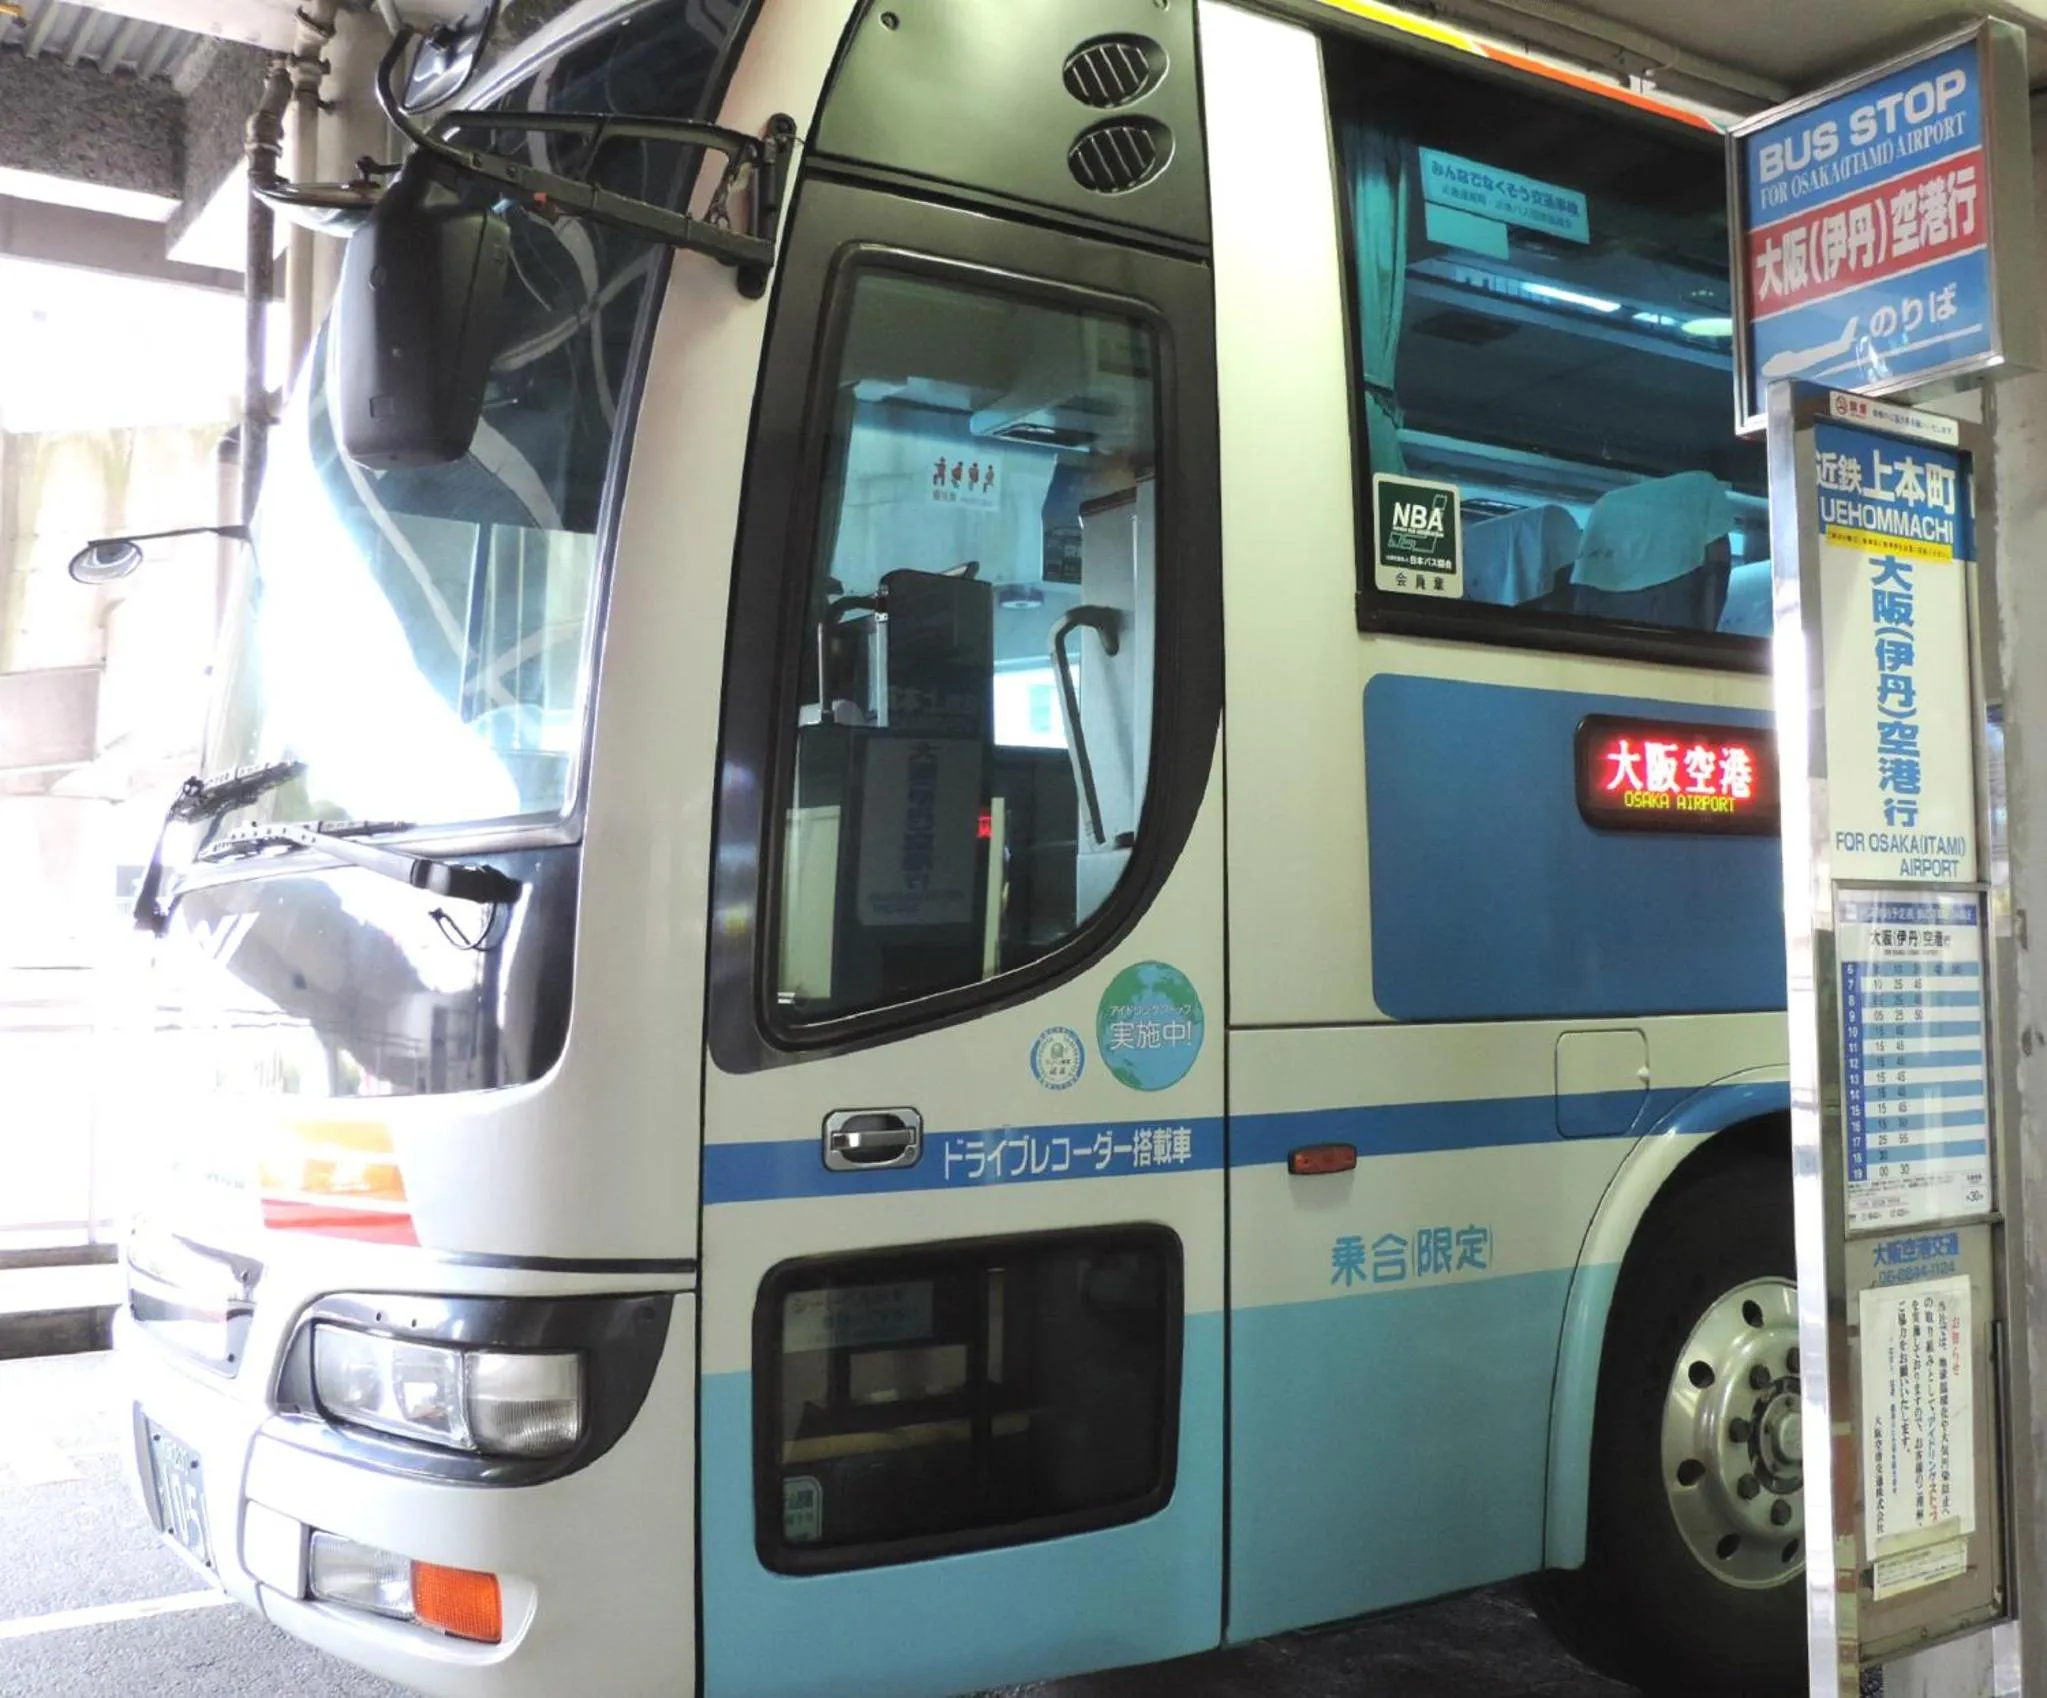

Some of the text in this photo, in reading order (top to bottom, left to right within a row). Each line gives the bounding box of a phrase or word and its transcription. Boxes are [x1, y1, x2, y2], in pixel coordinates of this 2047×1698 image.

[1759, 68, 1966, 184] BUS STOP
[1760, 183, 1787, 210] FOR
[1896, 111, 1966, 158] AIRPORT
[1756, 166, 1977, 301] 大阪(伊丹)空港行
[1869, 282, 1958, 337] のりば
[1816, 449, 1956, 515] 近鉄上本町
[1393, 502, 1444, 532] NBA
[1821, 497, 1953, 543] UEHOMMACHI
[1868, 555, 1921, 828] 大阪(伊丹)空港行
[1607, 740, 1752, 797] 大阪空港
[1624, 791, 1736, 814] OSAKA AIRPORT
[1836, 832, 1966, 856] FOR OSAKA(ITAMI)
[1900, 858, 1959, 878] AIRPORT
[1110, 1021, 1191, 1049] 実施中!
[1848, 1057, 1858, 1069] 12
[944, 1127, 1192, 1180] ドライブレコーダー搭載車
[1852, 1136, 1861, 1148] 17
[1853, 1168, 1862, 1179] 19
[1330, 1223, 1494, 1287] 乗合(限定)
